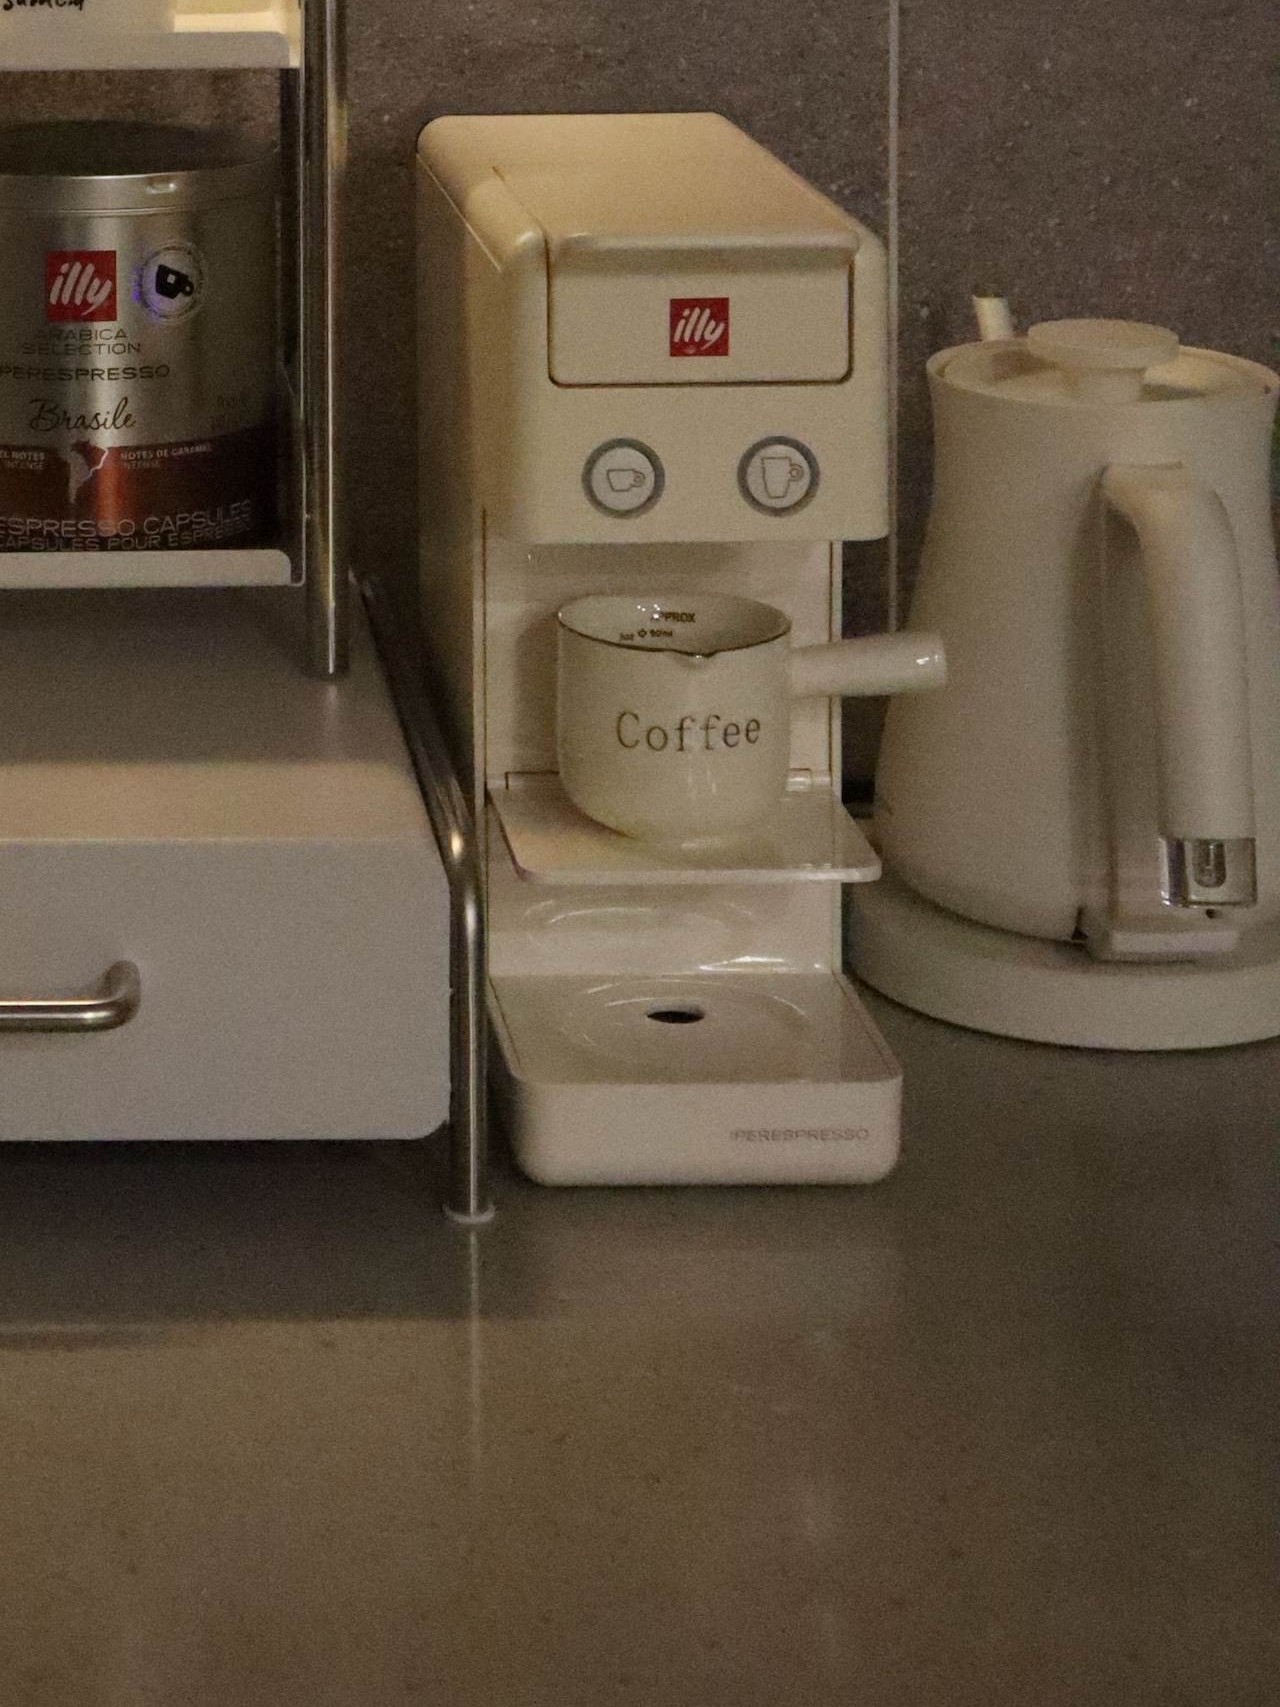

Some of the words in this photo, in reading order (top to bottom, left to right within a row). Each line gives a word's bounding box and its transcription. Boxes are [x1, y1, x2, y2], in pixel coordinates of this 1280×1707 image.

[48, 260, 113, 317] illy
[34, 328, 129, 341] ARABICA
[672, 305, 727, 351] illy
[22, 341, 142, 356] SELECTION
[28, 395, 138, 433] Brasile
[11, 450, 46, 462] NOTES
[120, 449, 154, 460] NOTES
[156, 449, 169, 458] DE
[142, 499, 252, 535] CAPSULES
[106, 537, 161, 551] POUR
[615, 710, 762, 753] Coffee
